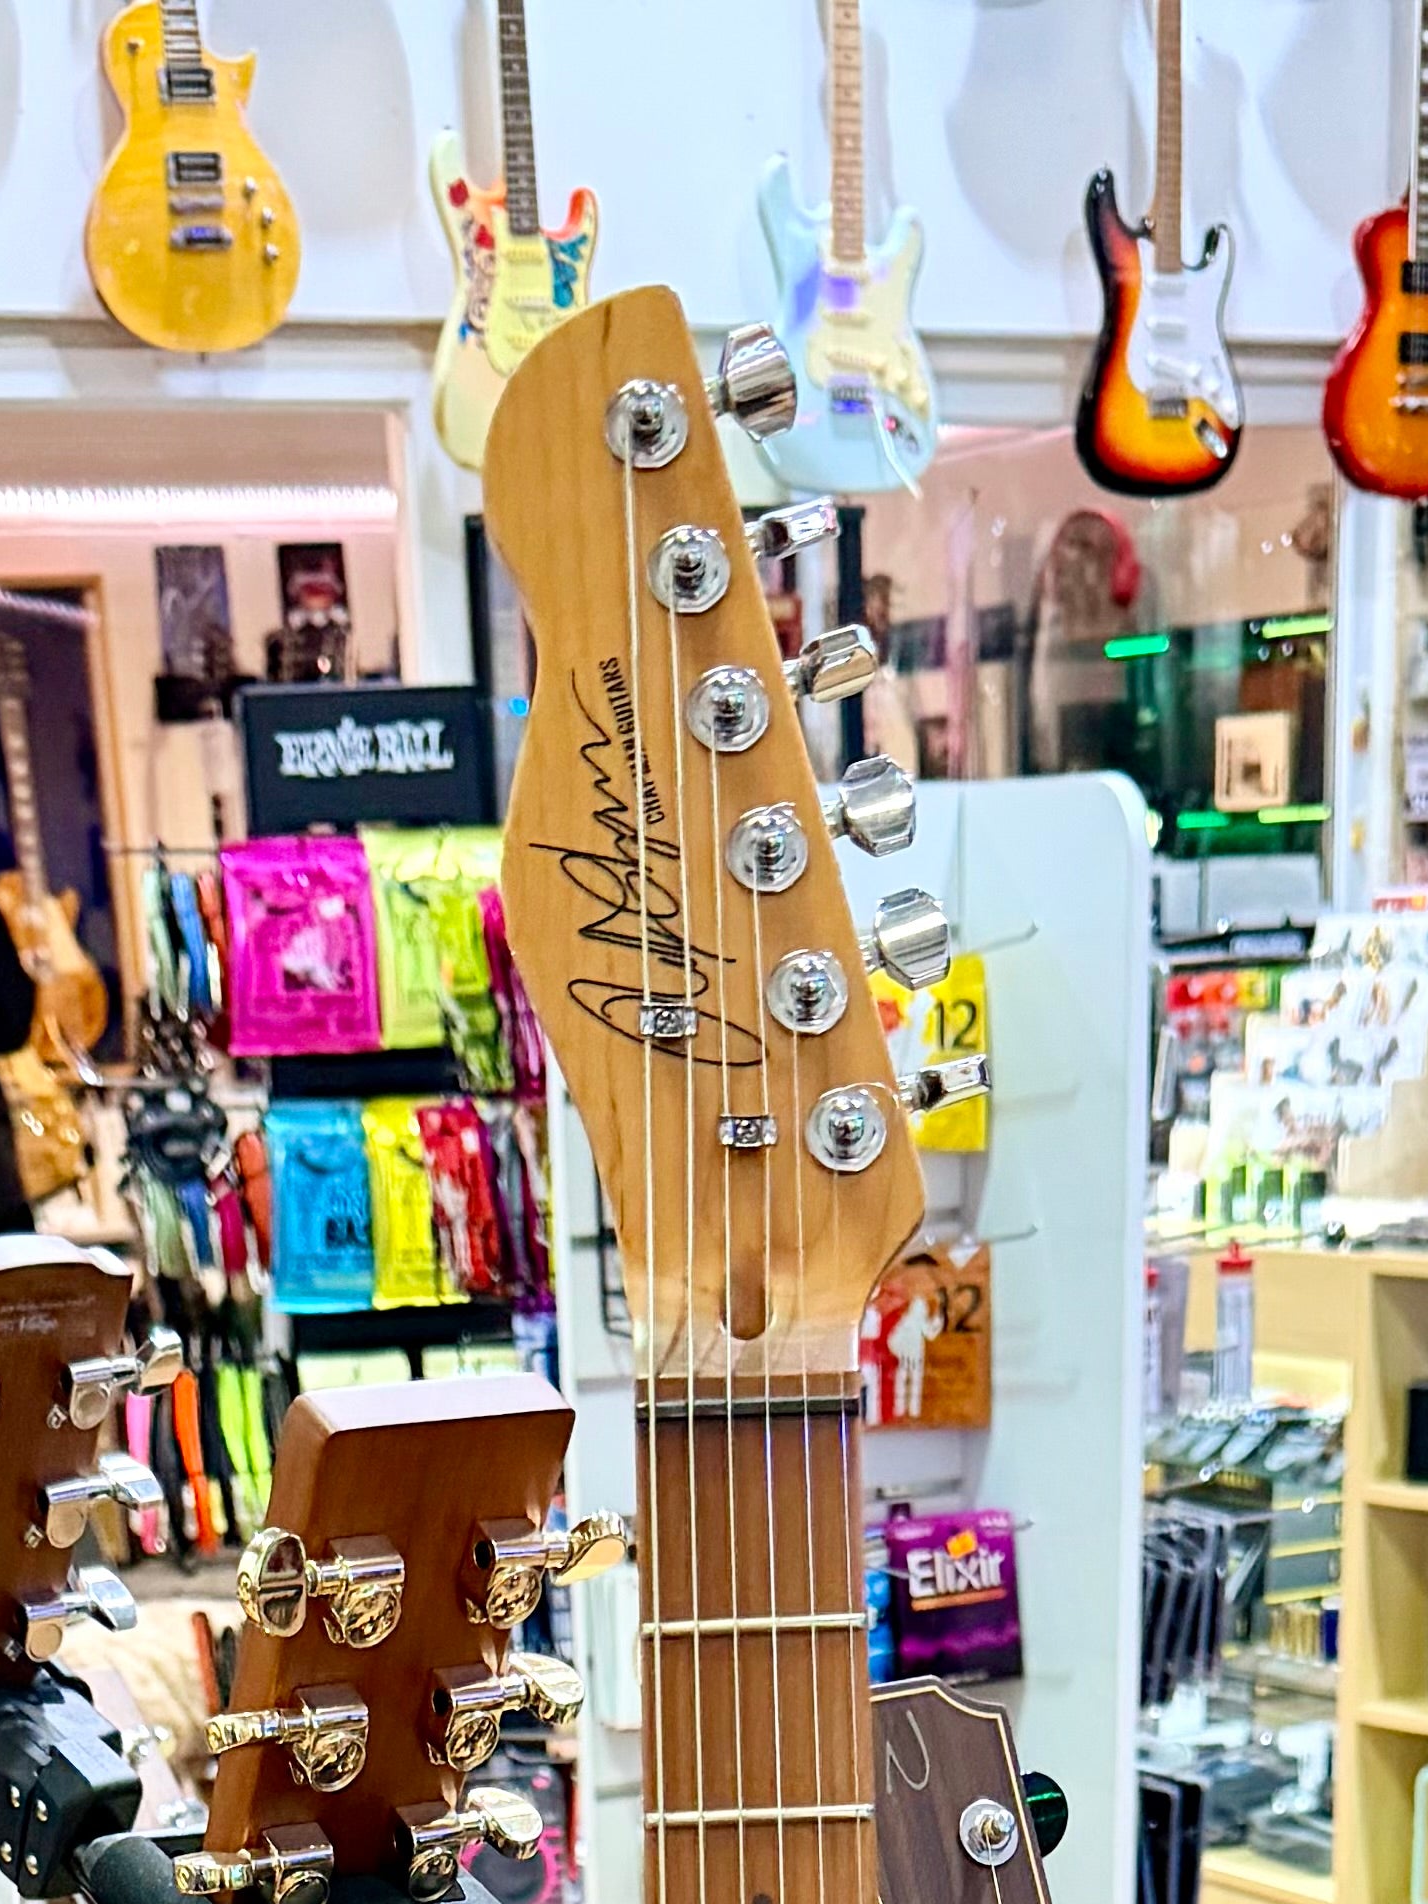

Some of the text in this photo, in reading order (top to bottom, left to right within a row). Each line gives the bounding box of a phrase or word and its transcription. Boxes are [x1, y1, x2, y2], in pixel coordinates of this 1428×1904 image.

[599, 657, 635, 735] GUITARS
[274, 715, 374, 778] ERNIE
[934, 999, 977, 1051] 12
[938, 1283, 982, 1333] 12
[906, 1543, 1006, 1598] Elixir
